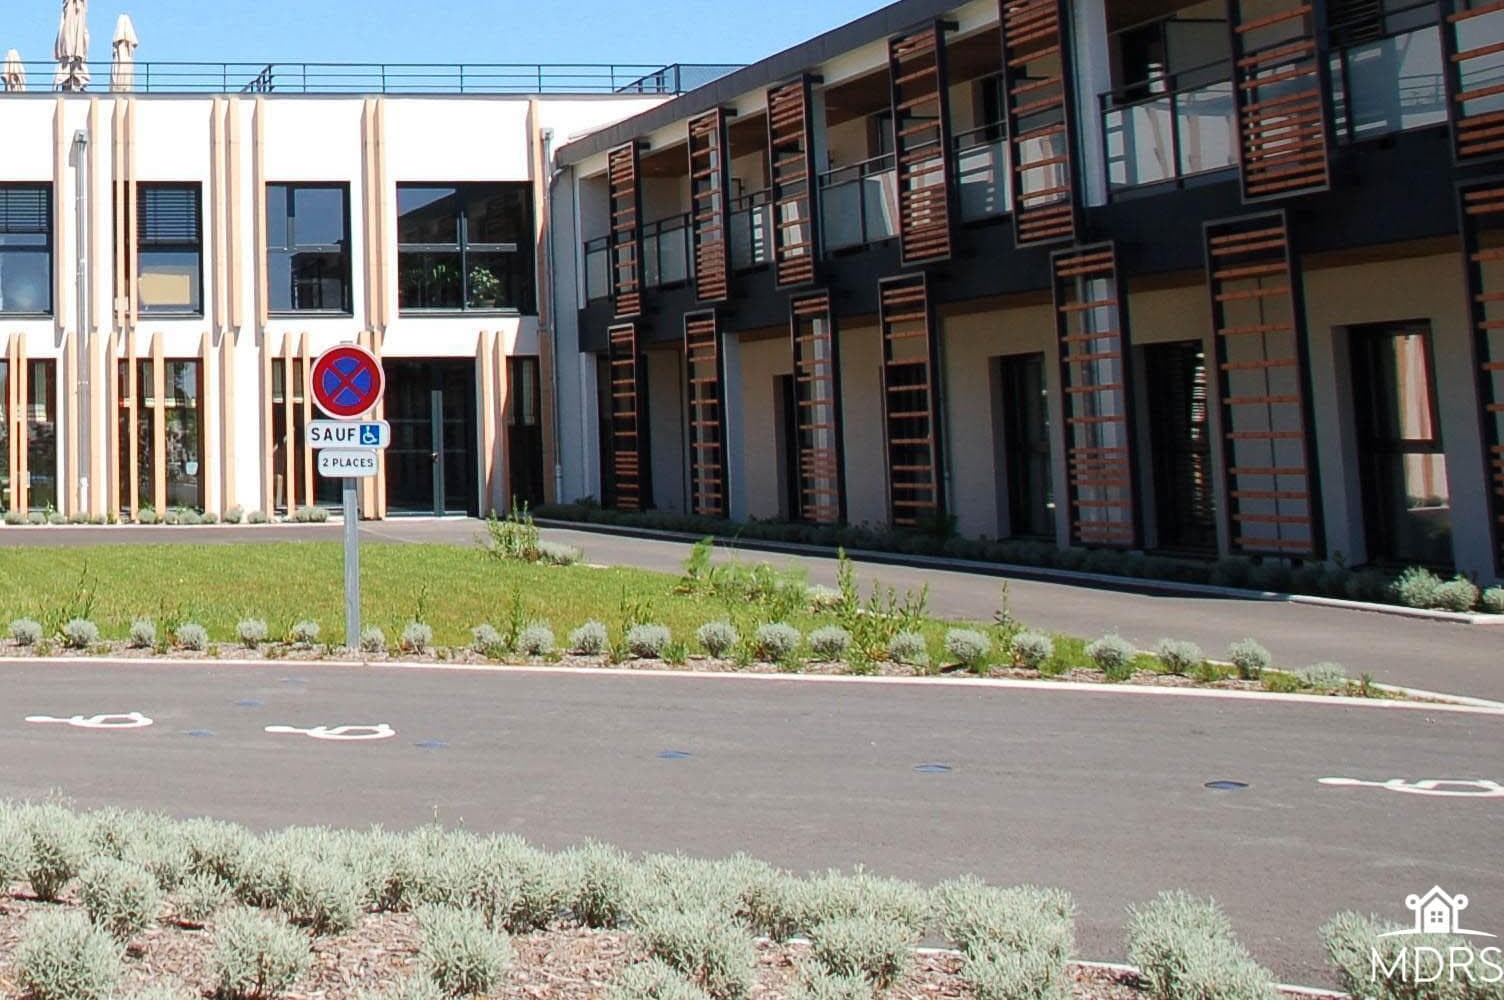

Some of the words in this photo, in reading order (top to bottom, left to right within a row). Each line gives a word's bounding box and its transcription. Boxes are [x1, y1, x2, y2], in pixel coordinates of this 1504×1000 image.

[311, 427, 356, 441] SAUF
[322, 458, 329, 467] 2
[332, 458, 374, 467] PLACES
